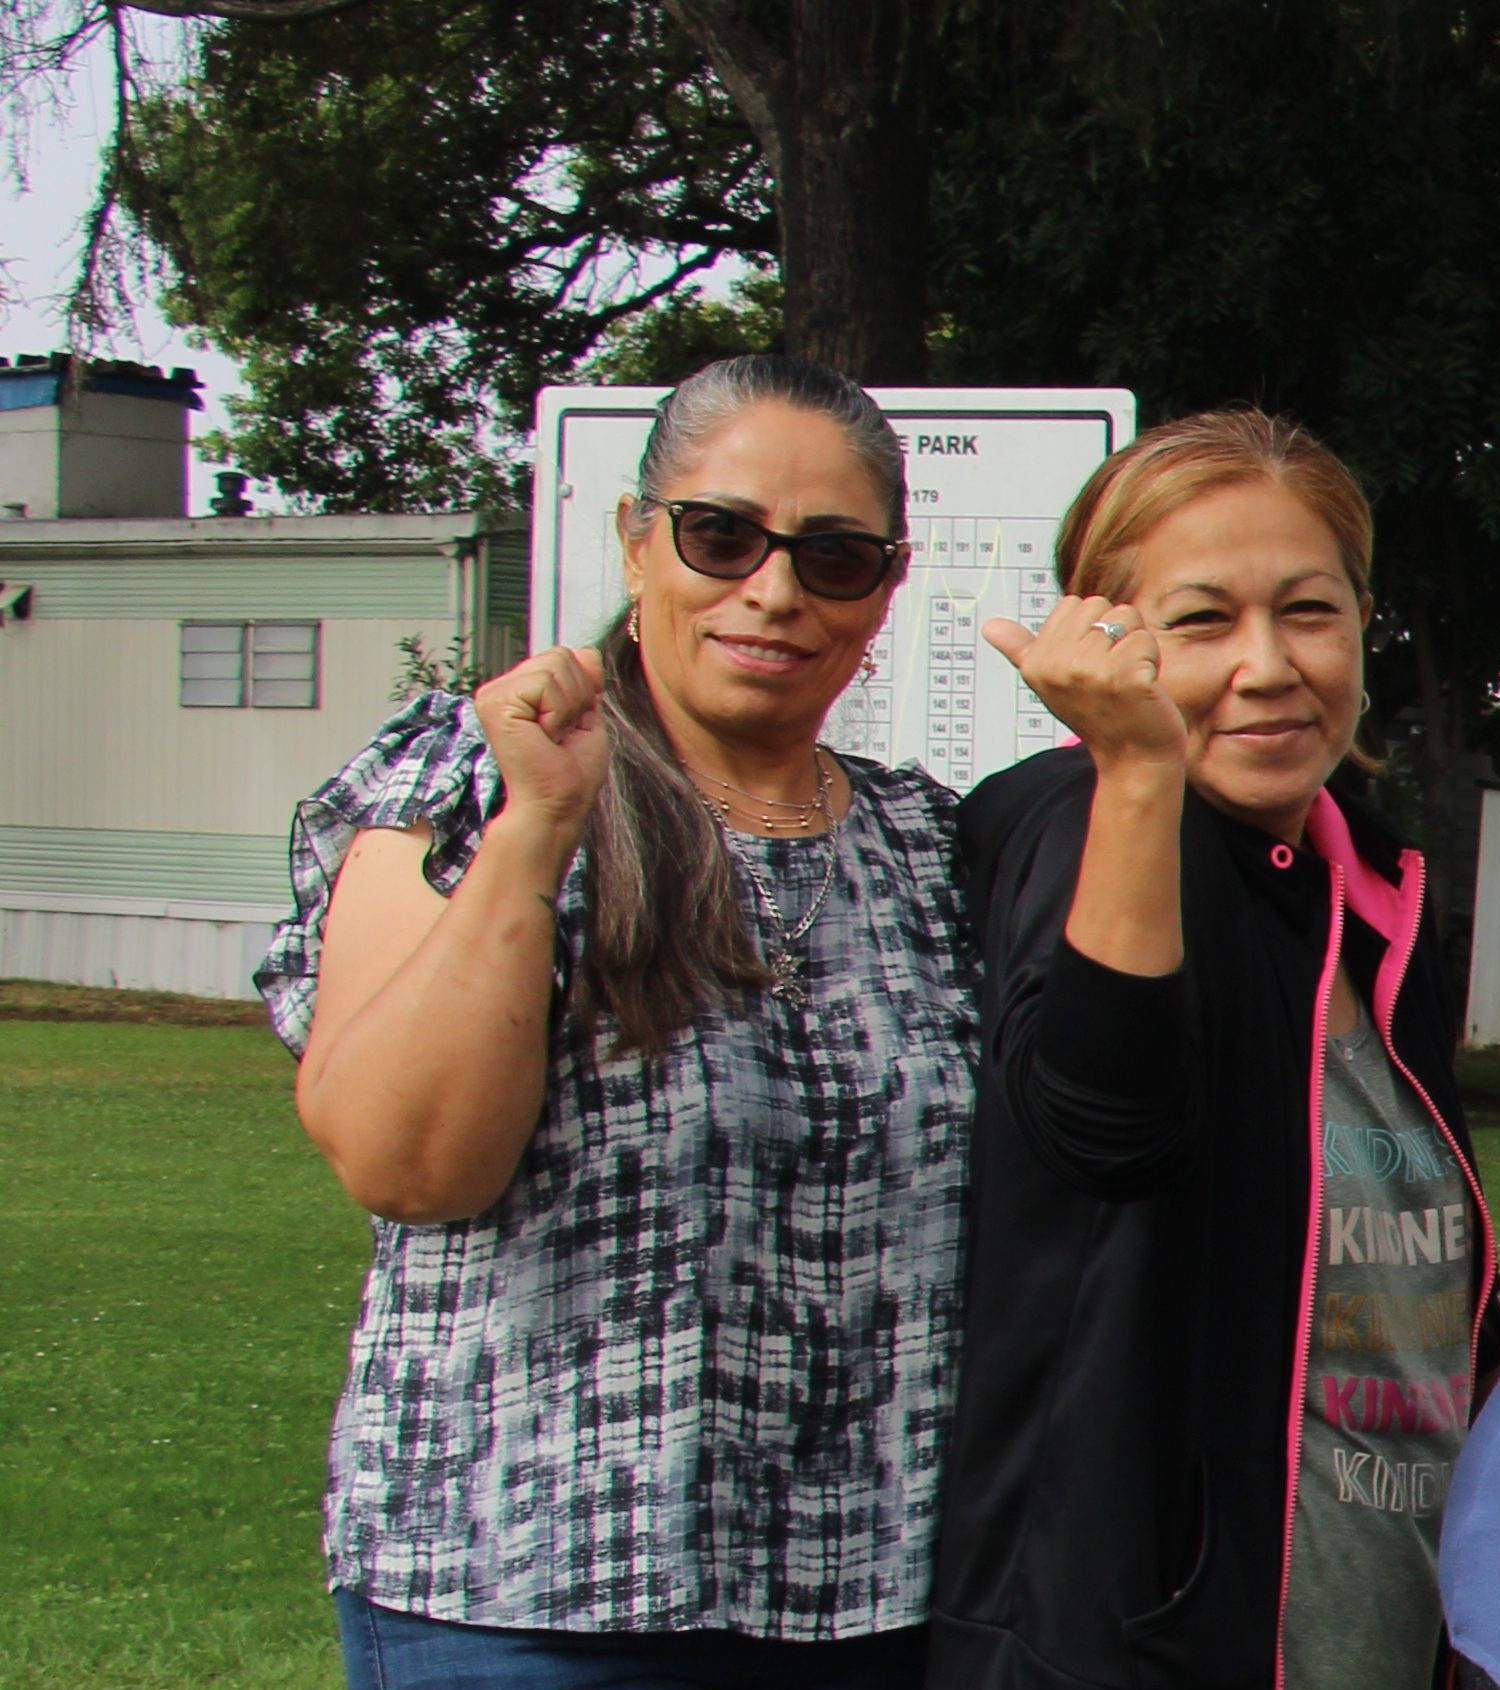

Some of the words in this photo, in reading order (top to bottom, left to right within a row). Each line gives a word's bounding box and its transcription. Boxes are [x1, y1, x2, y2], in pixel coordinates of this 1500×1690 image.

[897, 435, 909, 454] E
[918, 435, 979, 454] PARK
[956, 543, 969, 552] 191
[935, 627, 948, 636] 147
[956, 675, 970, 685] 151
[955, 747, 969, 757] 154
